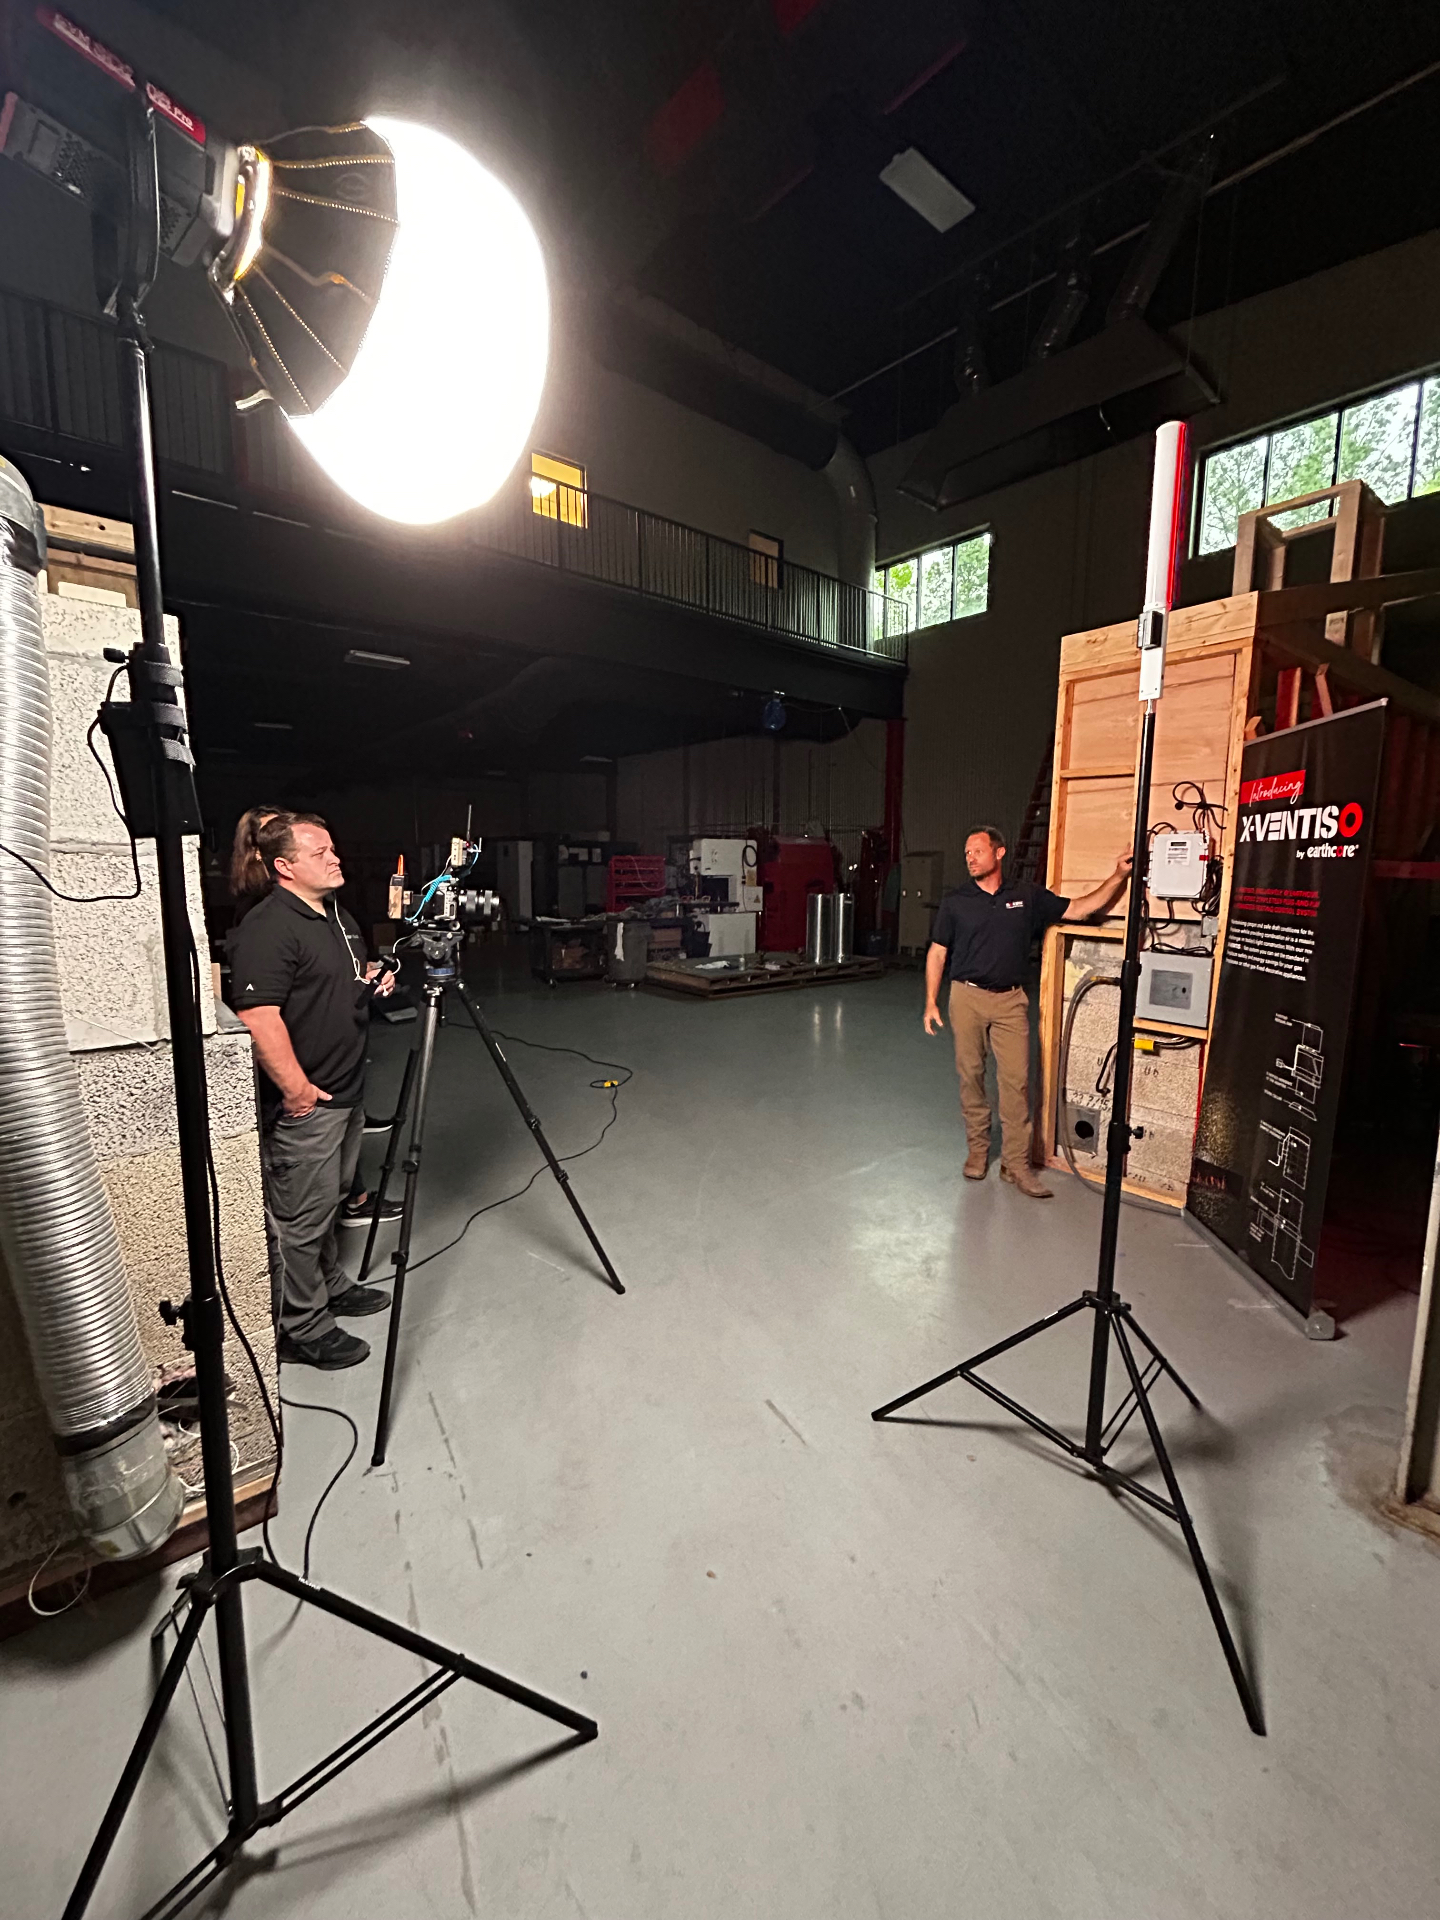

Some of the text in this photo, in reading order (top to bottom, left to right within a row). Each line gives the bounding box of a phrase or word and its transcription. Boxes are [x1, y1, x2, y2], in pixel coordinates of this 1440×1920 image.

[1248, 776, 1304, 808] Introducing
[1239, 801, 1364, 843] X-VENTISO
[1295, 849, 1306, 860] by
